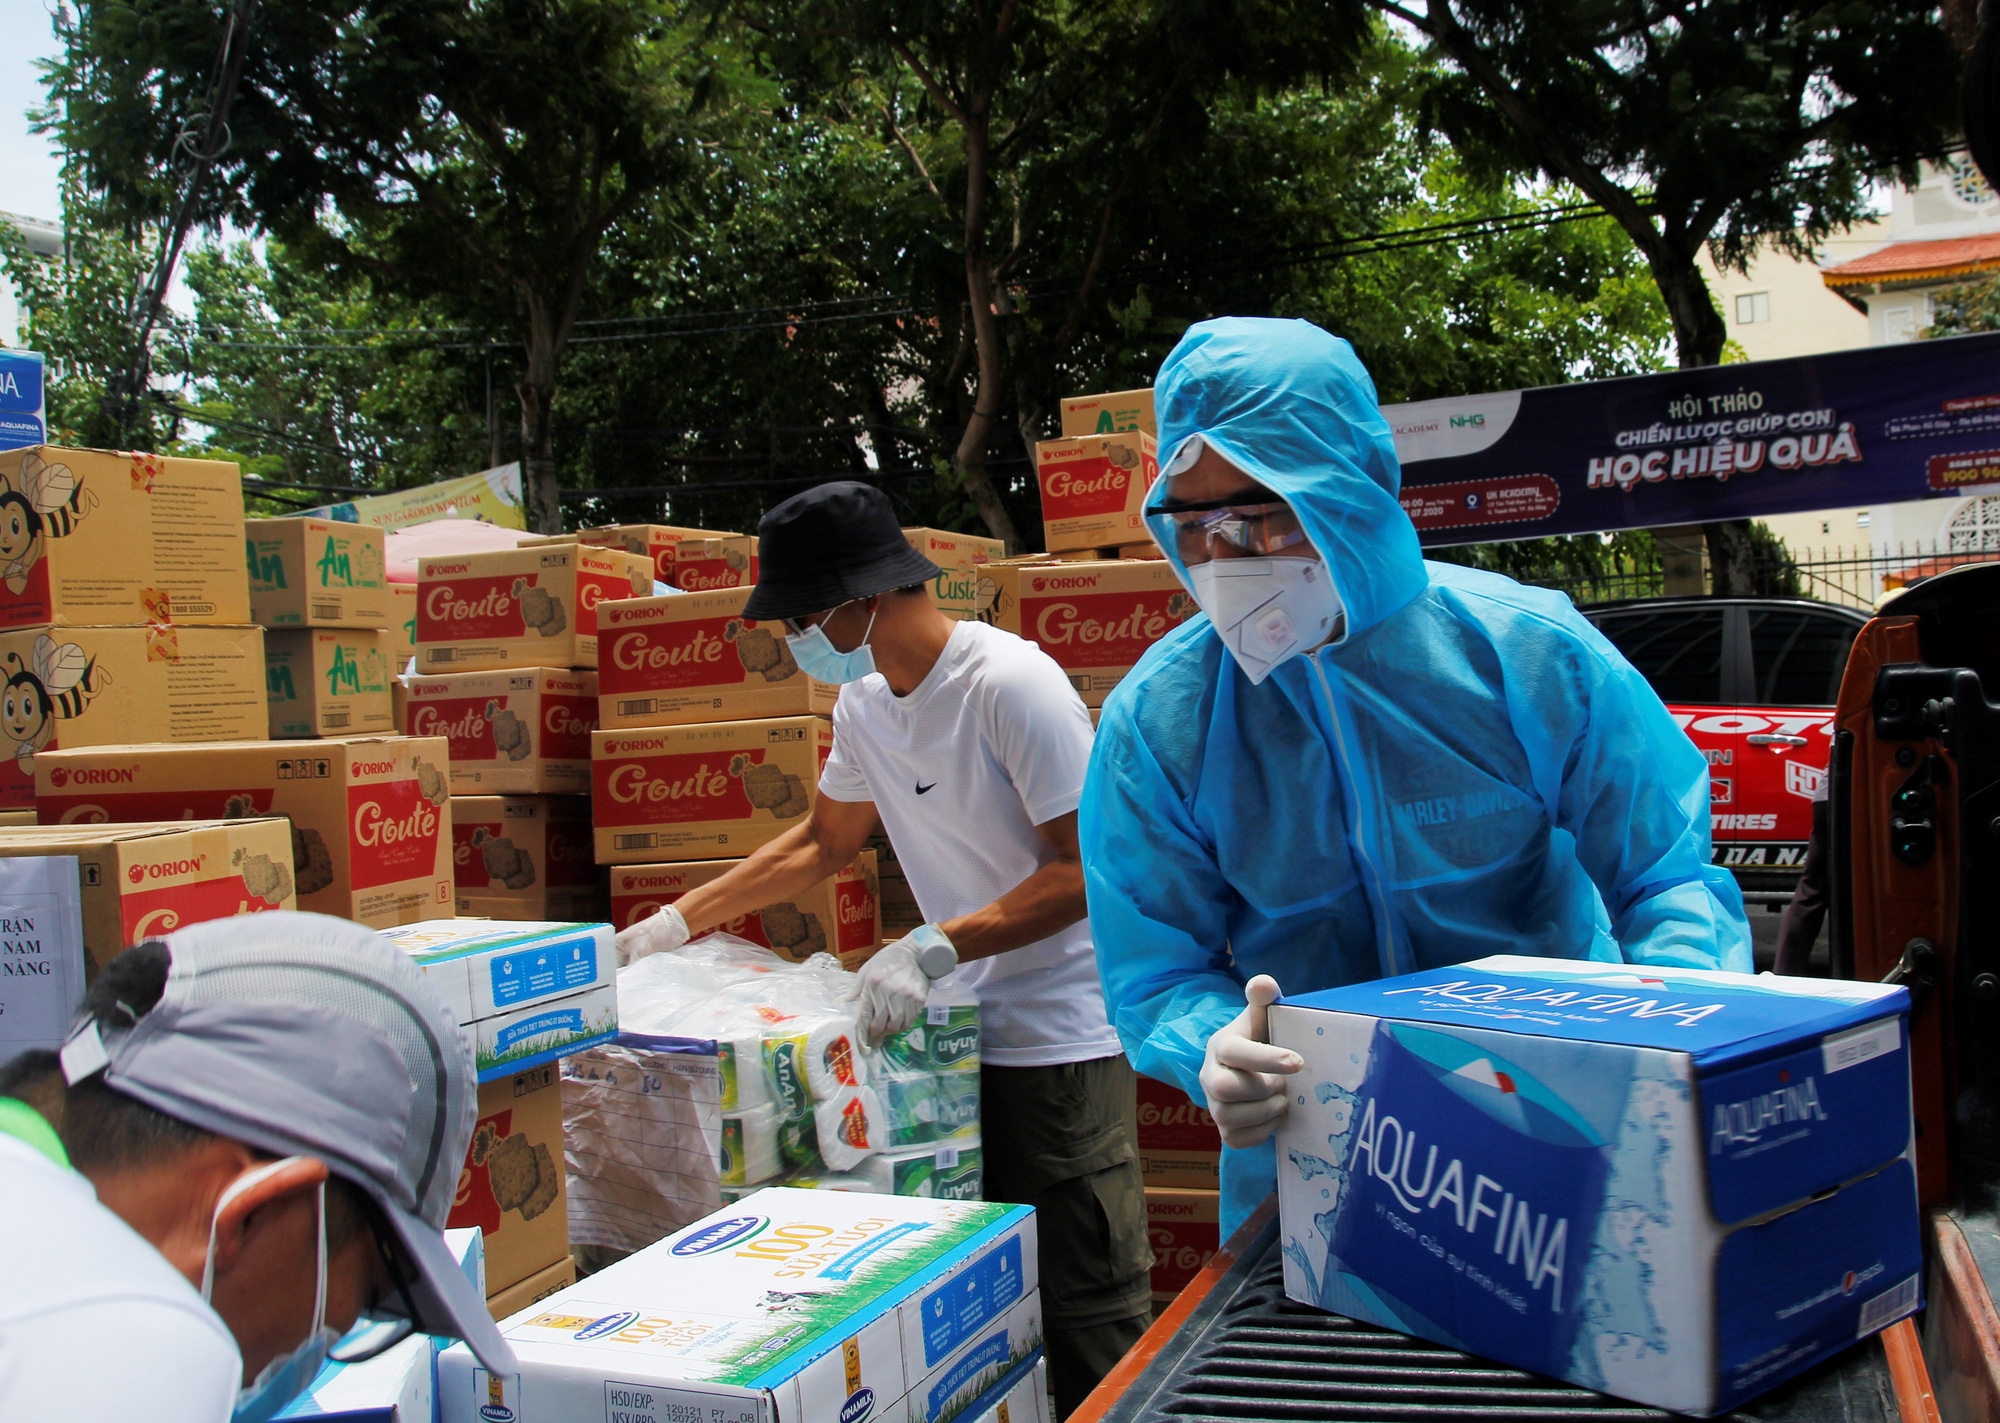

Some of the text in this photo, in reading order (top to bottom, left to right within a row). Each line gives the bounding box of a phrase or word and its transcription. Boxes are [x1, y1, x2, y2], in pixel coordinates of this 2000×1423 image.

[1669, 387, 1763, 423] HỘI THẢO
[1396, 423, 1439, 436] ACADEMY
[1450, 414, 1486, 428] NHG
[1615, 409, 1832, 448] CHIẾN LƯỢC GIÚP CON
[1053, 448, 1083, 459] ORION
[1587, 421, 1862, 491] HỌC HIỆU QUẢ
[1045, 468, 1126, 499] Gouté
[1943, 468, 1979, 483] 1900
[1132, 517, 1138, 525] 8
[661, 532, 684, 542] ORION
[937, 541, 956, 551] ORION
[316, 535, 353, 587] An
[437, 564, 467, 576] ORION
[592, 558, 613, 571] ORION
[679, 568, 738, 589] Gouté
[1049, 576, 1097, 589] ORION
[426, 585, 511, 622] Gouté
[624, 608, 665, 620] ORION
[1037, 602, 1166, 646] Gouté
[613, 630, 723, 670] Gouté
[326, 644, 360, 696] An
[424, 683, 449, 695] ORION
[557, 679, 585, 691] ORION
[414, 705, 485, 739] Gouté
[621, 739, 665, 751] ORION
[74, 768, 133, 784] ORION
[363, 762, 394, 775] ORION
[608, 764, 728, 804] Gouté
[354, 801, 435, 847] Gouté
[1711, 814, 1777, 830] TIRES
[1723, 848, 1765, 865] DA
[149, 858, 201, 880] ORION
[638, 875, 682, 888] ORION
[441, 885, 446, 899] 8
[840, 893, 874, 925] Gouté
[3, 939, 42, 955] NAM
[3, 959, 51, 977] NẴNG
[1382, 980, 1726, 1028] AQUAFINA
[778, 1052, 798, 1115] AnAn
[1710, 1075, 1824, 1156] AQUAFINA
[1146, 1203, 1194, 1216] ORION
[1349, 1097, 1569, 1316] AQUAFINA
[1386, 1211, 1417, 1239] ngon
[674, 1217, 753, 1255] VINAMILK
[574, 1311, 632, 1340] VINAMILK
[611, 1390, 655, 1411] HSD/EXP:
[841, 1391, 873, 1423] VINAMILK
[481, 1406, 512, 1418] VINAMILK
[666, 1404, 755, 1423] 120121 P7 08
